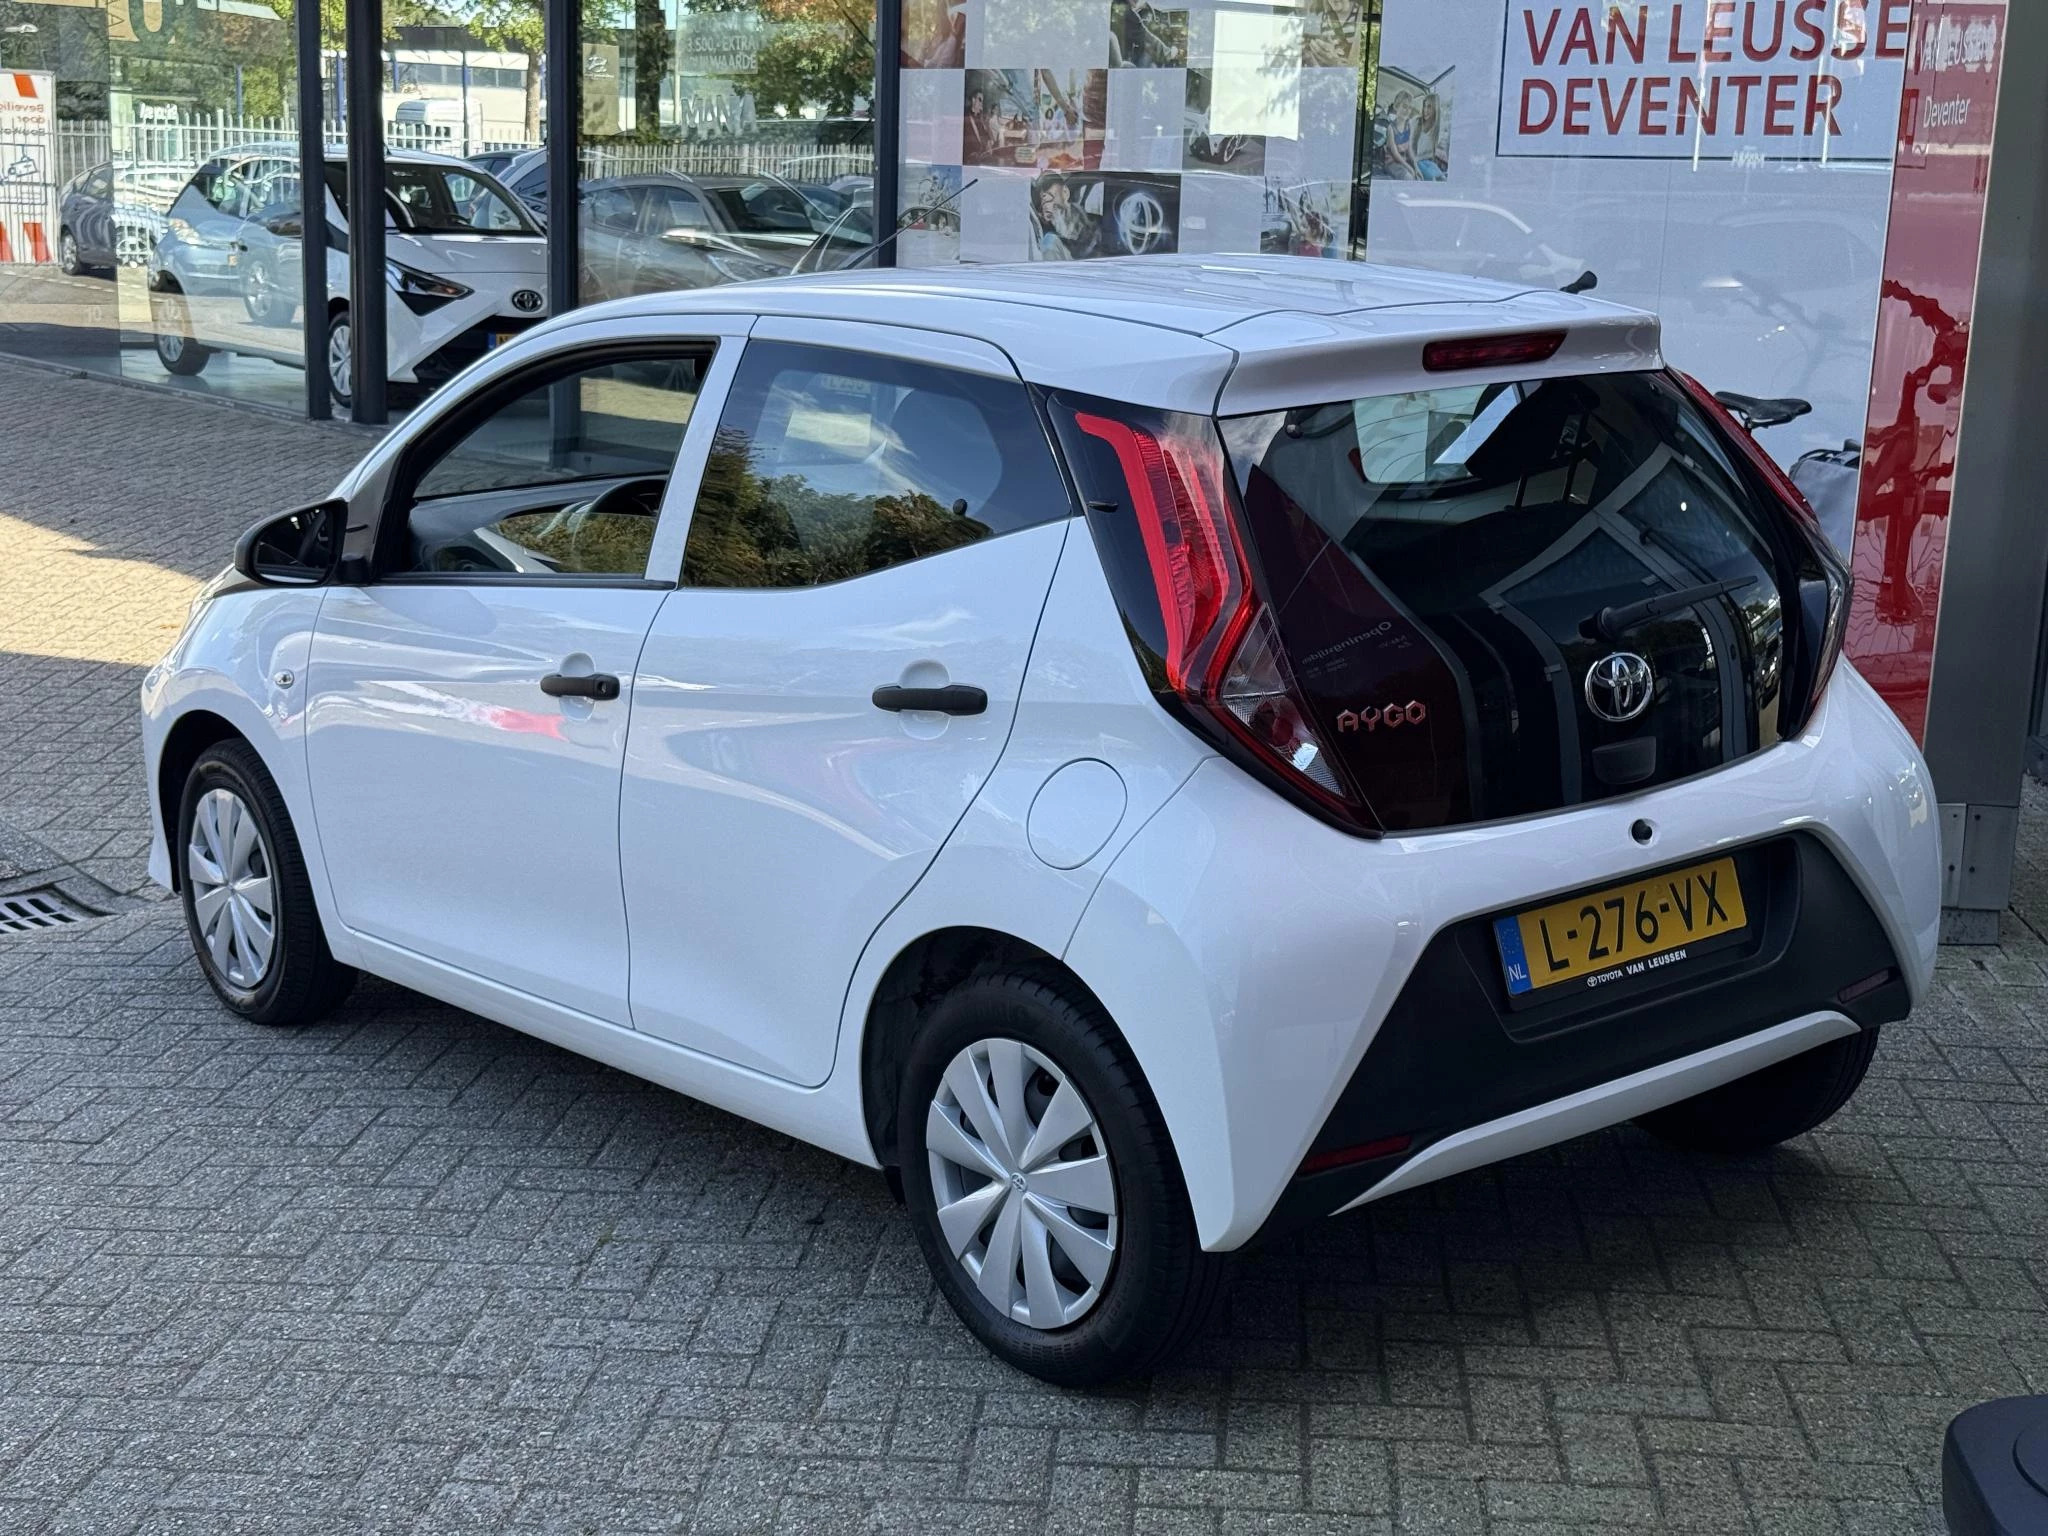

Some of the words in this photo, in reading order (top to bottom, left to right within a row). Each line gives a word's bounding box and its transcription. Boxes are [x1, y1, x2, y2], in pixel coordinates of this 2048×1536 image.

[1522, 4, 1648, 66] VAN
[1518, 75, 1843, 137] DEVENTER
[1923, 94, 1971, 128] Deventer
[1336, 699, 1427, 733] AYGO
[1508, 964, 1527, 982] NL
[1539, 870, 1728, 973] L-276-VX
[1597, 970, 1623, 984] TOYOTA
[1626, 962, 1645, 975] VAN
[1648, 949, 1687, 968] LEUSSEN
